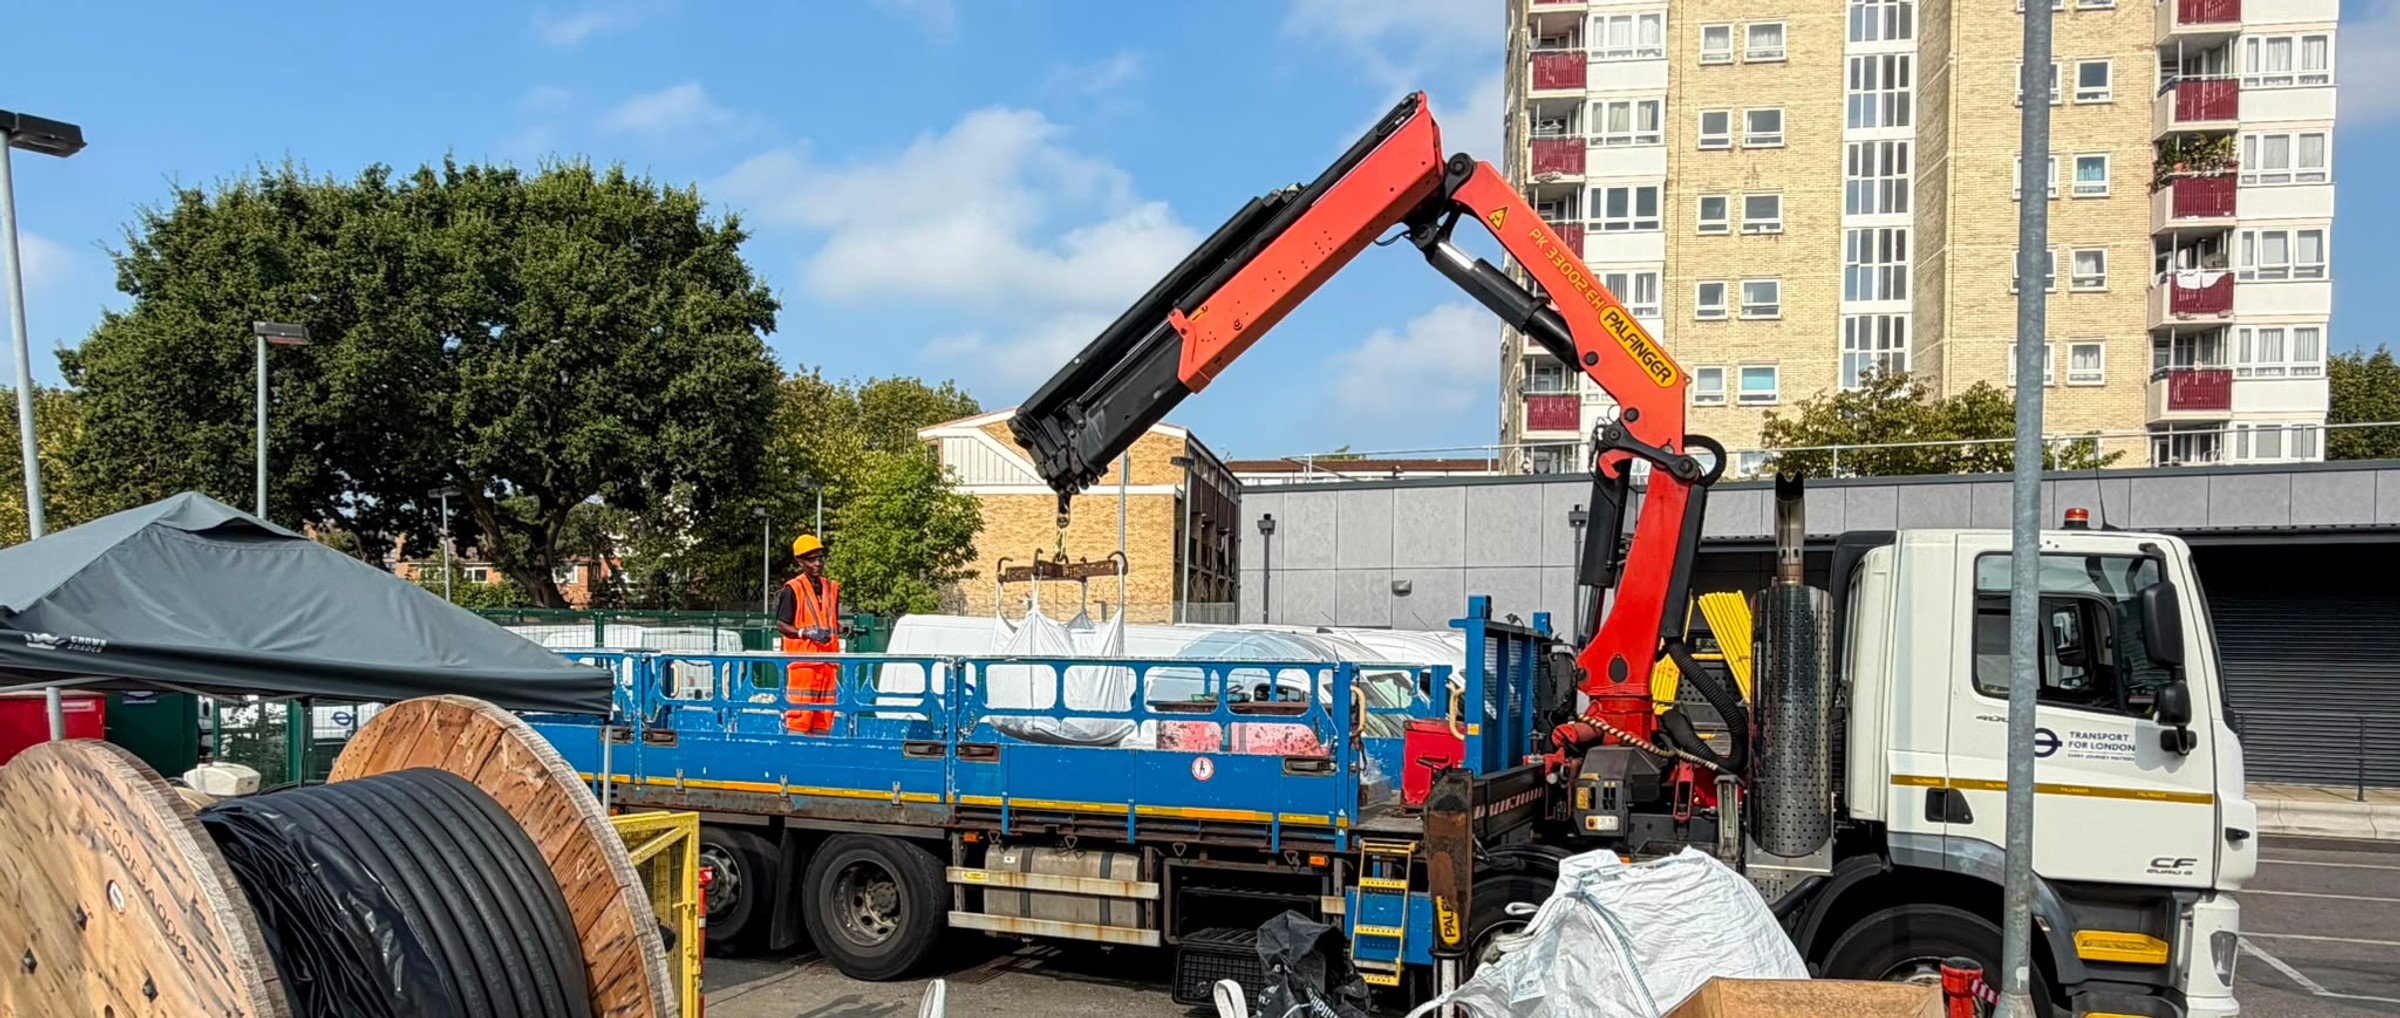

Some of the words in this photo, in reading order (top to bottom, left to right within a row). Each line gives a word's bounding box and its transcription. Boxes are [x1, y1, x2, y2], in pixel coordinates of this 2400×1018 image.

[1528, 227, 1549, 249] PK
[1603, 310, 1672, 384] PALFINGER
[70, 635, 107, 647] CROWN
[2069, 731, 2129, 741] TRANSPORT
[2068, 740, 2088, 749] FOR
[2090, 742, 2136, 751] LONDON
[2150, 857, 2198, 868] CF
